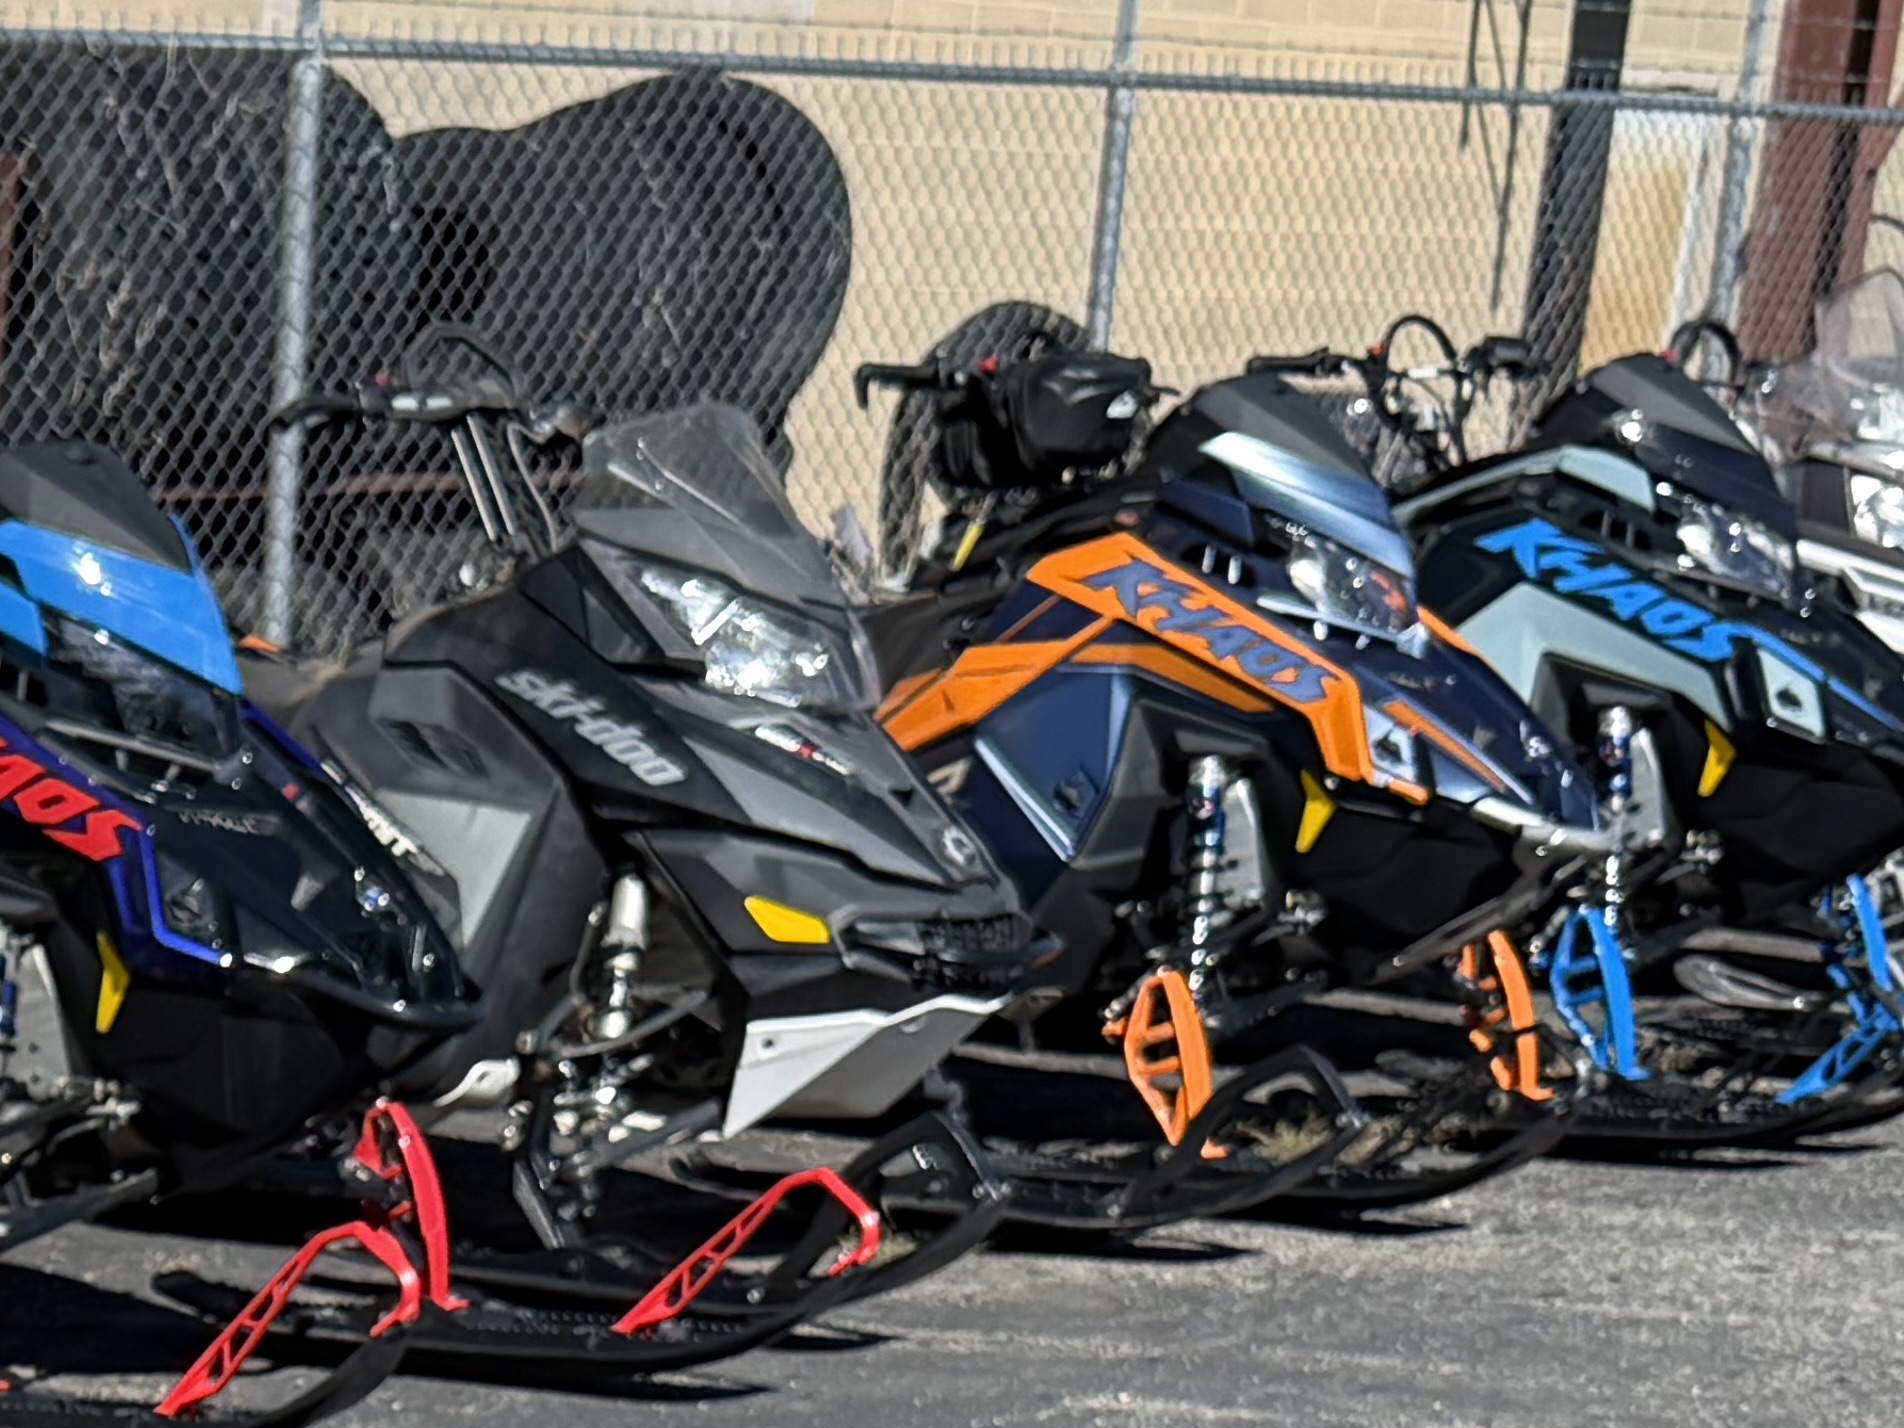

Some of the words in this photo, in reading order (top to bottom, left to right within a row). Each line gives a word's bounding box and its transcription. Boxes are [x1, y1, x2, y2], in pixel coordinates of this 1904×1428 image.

[1080, 559, 1341, 702] KHAOS
[1474, 517, 1772, 661] KHAOS
[494, 671, 686, 785] ski-doo
